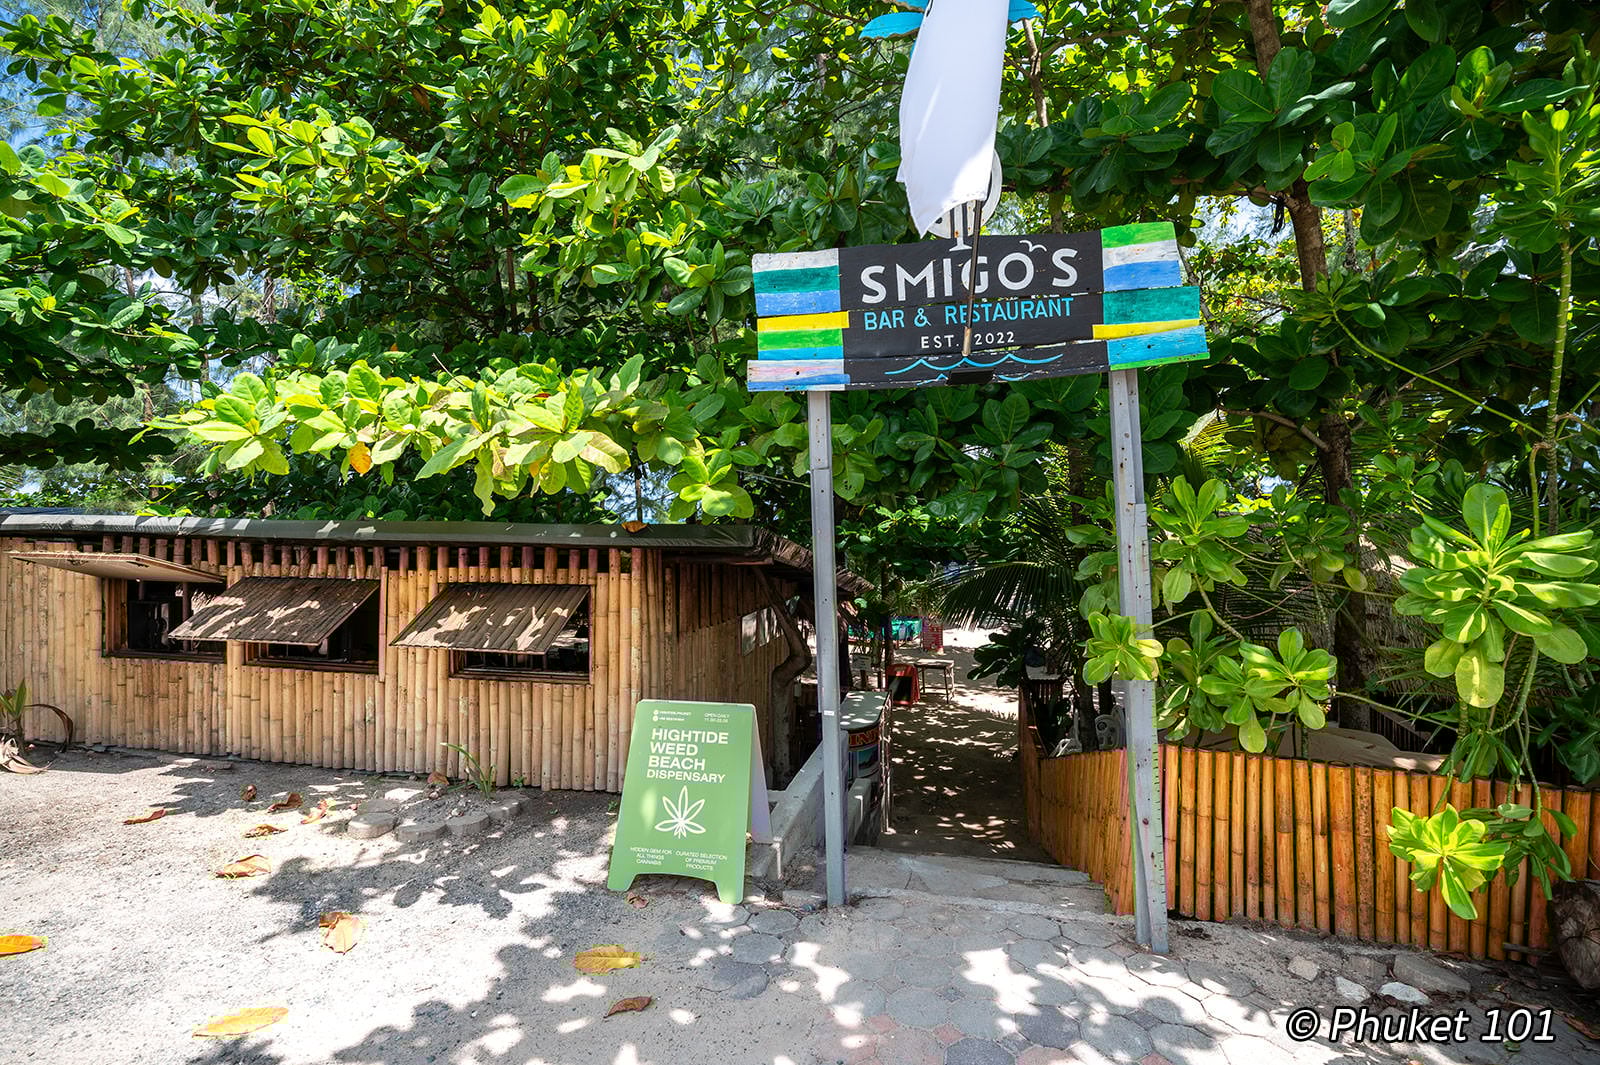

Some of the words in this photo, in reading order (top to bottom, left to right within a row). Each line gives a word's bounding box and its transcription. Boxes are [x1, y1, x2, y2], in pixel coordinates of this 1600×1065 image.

[860, 247, 1079, 304] SMIGO'S
[864, 309, 906, 331] BAR
[913, 308, 932, 328] &
[945, 297, 1075, 325] RESTAURANT
[921, 334, 960, 349] EST.
[974, 331, 1016, 346] 2022
[651, 728, 729, 744] HIGHTIDE
[650, 741, 699, 756] WEED
[648, 755, 706, 771] BEACH
[646, 769, 726, 783] DISPENSARY
